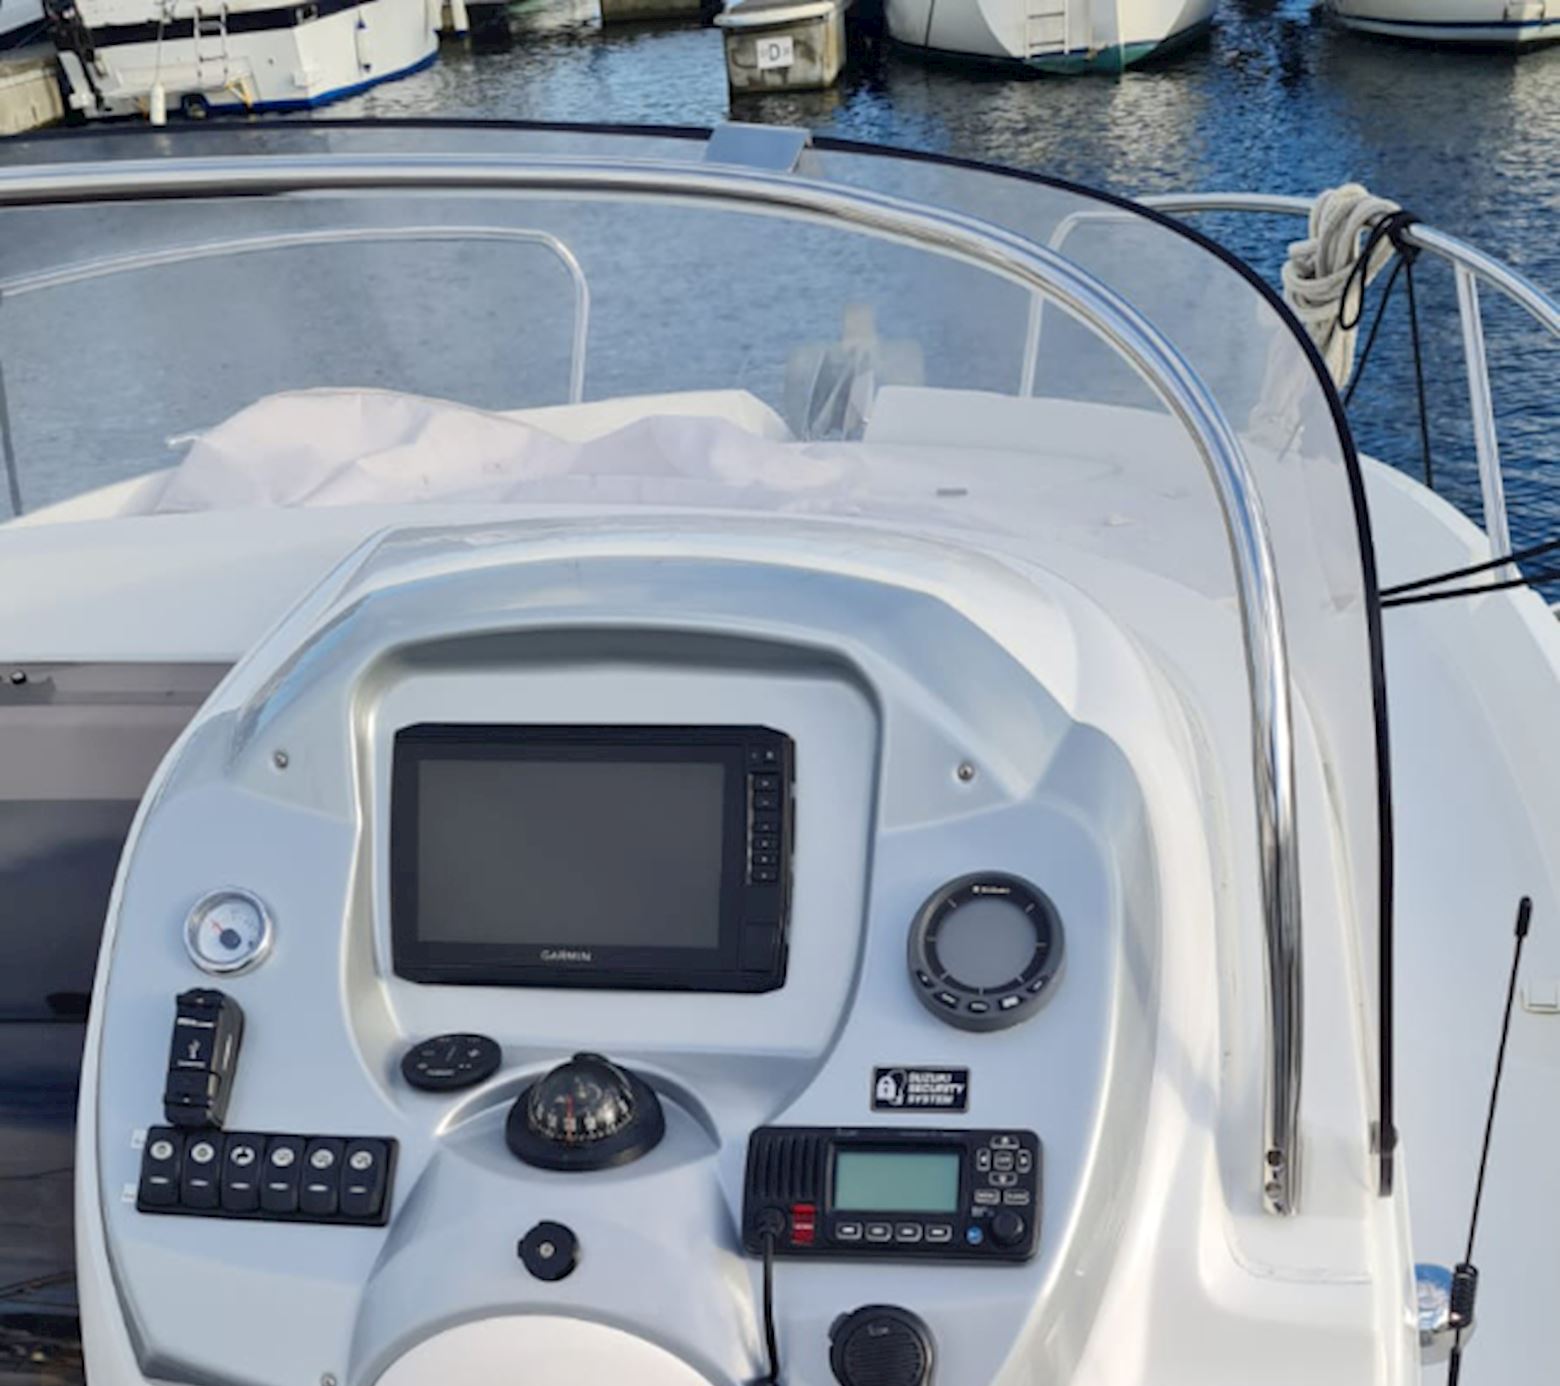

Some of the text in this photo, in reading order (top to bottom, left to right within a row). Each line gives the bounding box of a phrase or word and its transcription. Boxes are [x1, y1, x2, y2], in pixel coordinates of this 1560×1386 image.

[768, 43, 780, 61] D
[540, 949, 592, 962] GARMIN
[908, 1071, 953, 1083] SUZUKI
[907, 1083, 965, 1094] SECURITY
[907, 1094, 955, 1106] SYSTEM
